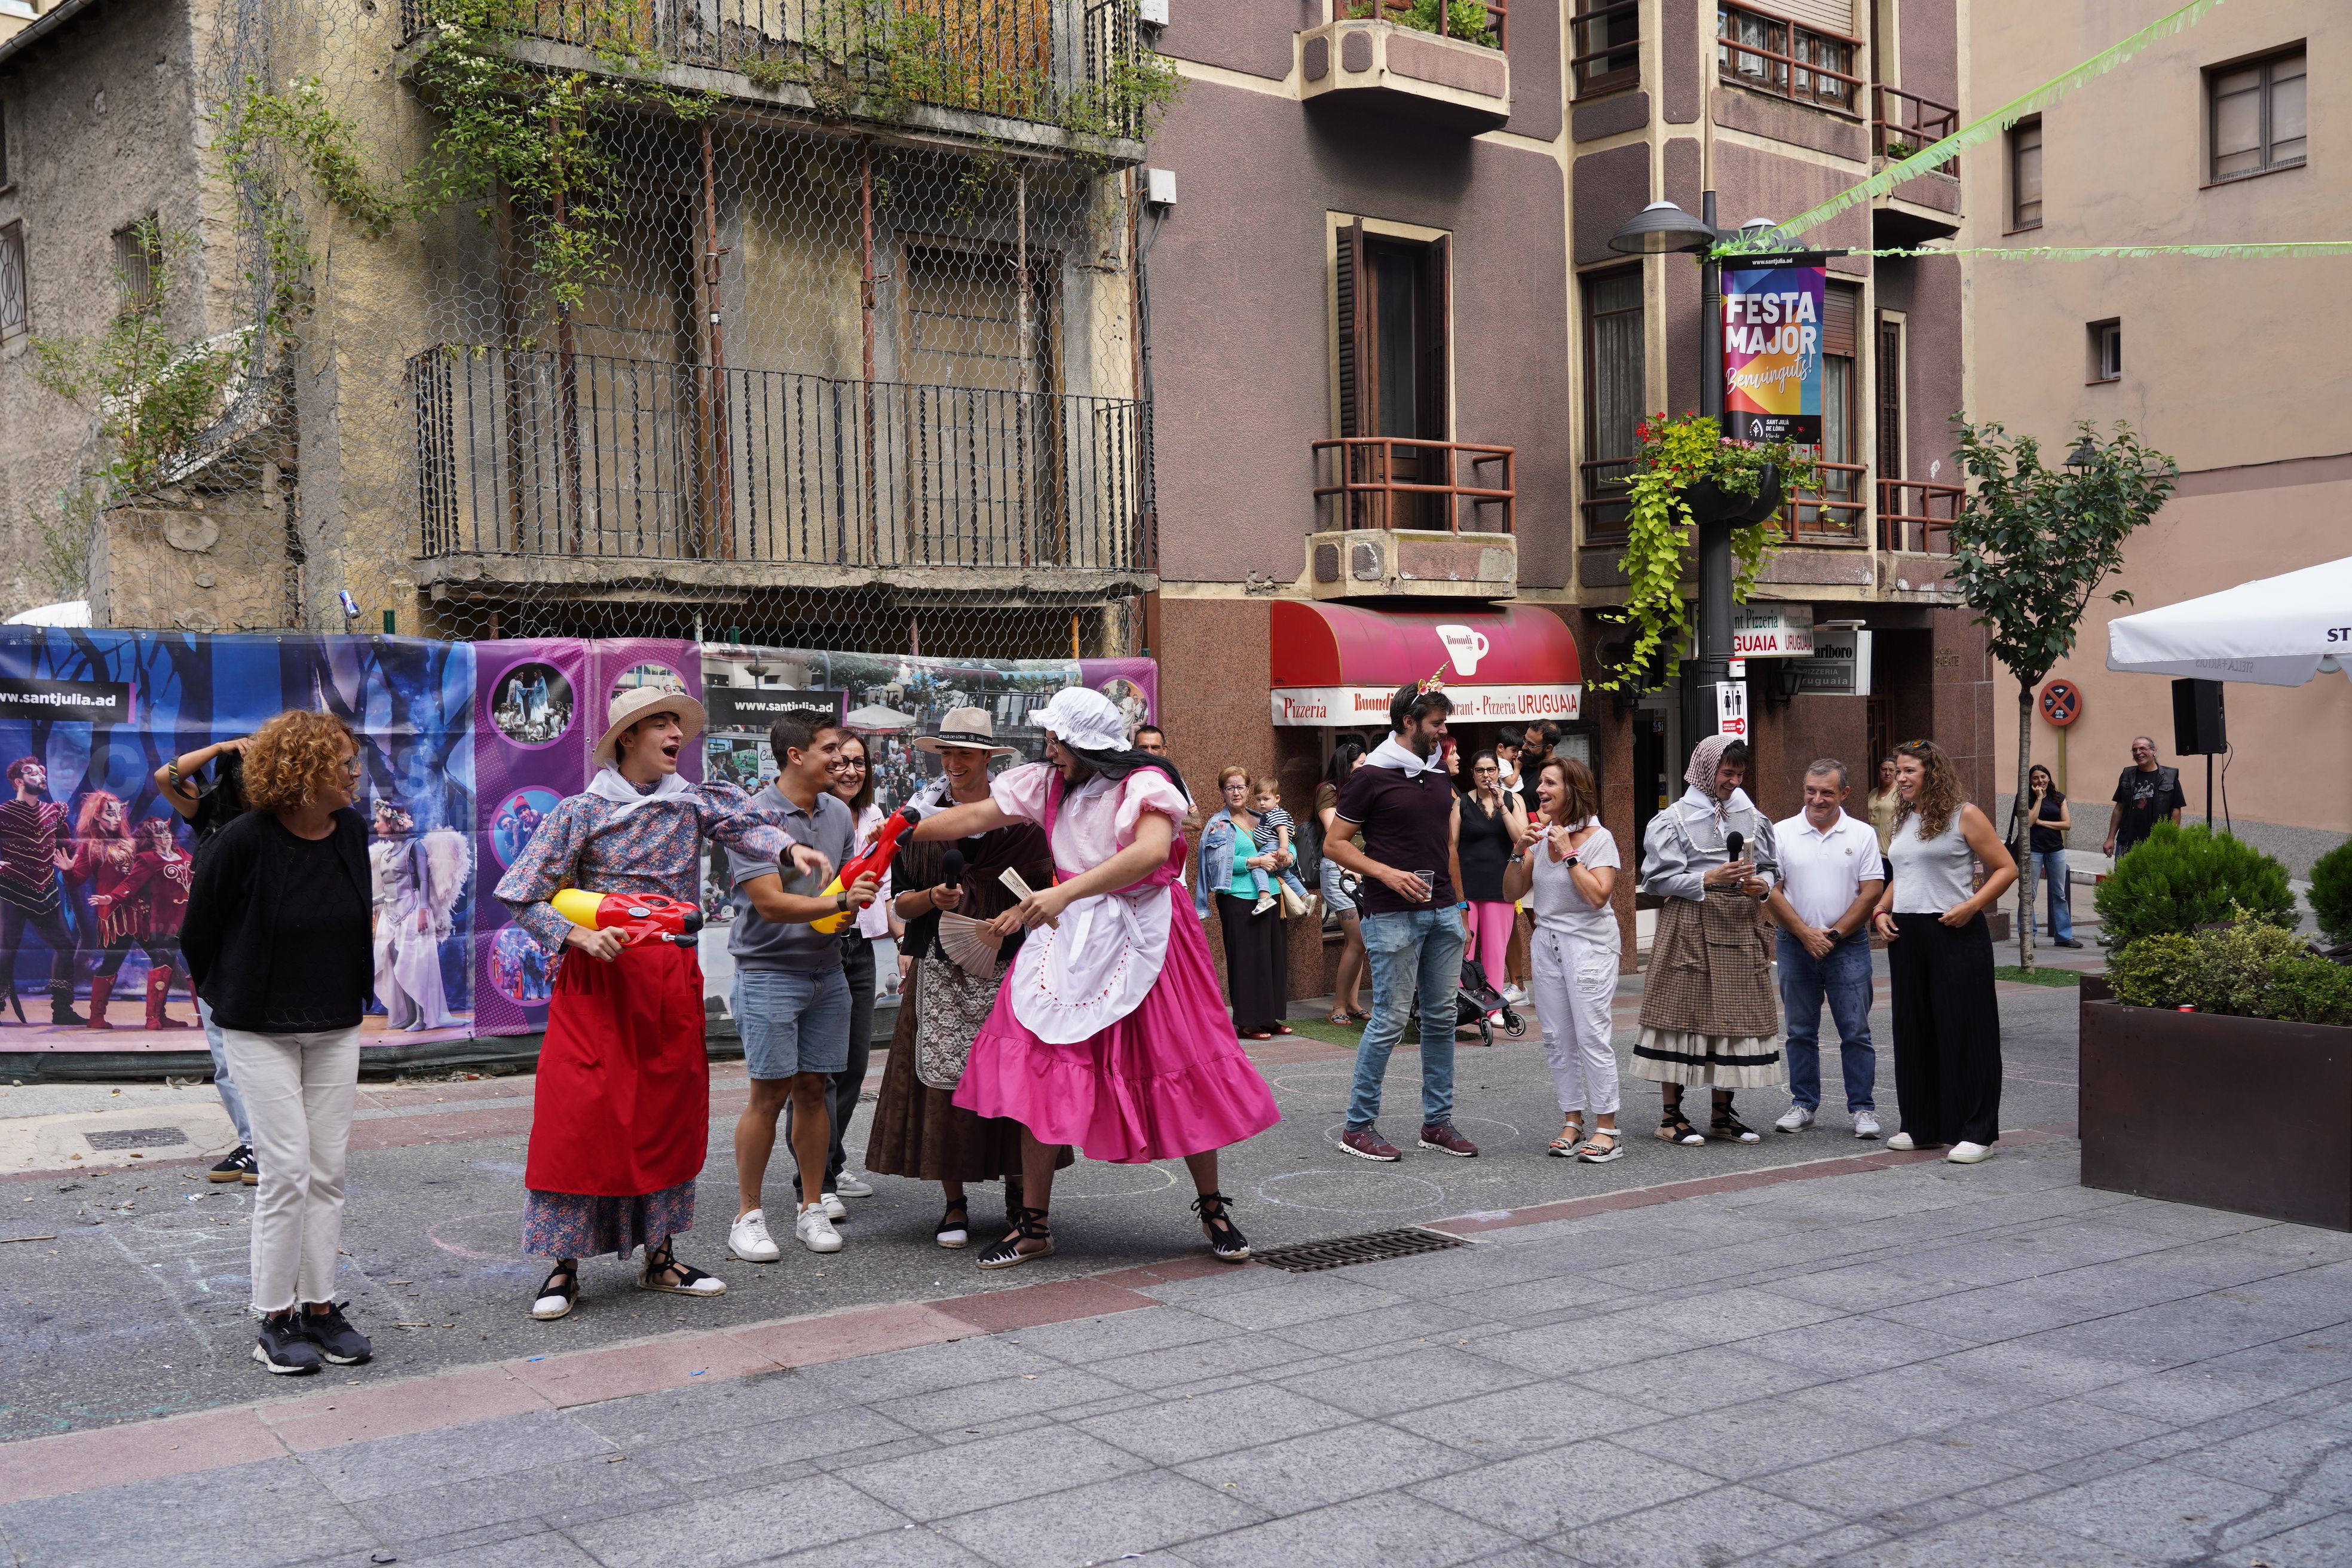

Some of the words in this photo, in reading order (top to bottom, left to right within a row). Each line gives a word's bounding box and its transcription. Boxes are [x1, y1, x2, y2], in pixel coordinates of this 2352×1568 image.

[1726, 292, 1817, 324] FESTA
[1726, 326, 1817, 354] MAJOR
[1726, 353, 1812, 394] Benvinguts!
[1745, 609, 1778, 629] Pizzeria
[1446, 635, 1472, 645] Buondi
[1734, 635, 1777, 651] GUAIA
[1785, 635, 1813, 651] URUGUAIA
[1814, 644, 1852, 658] arlboro
[1802, 677, 1848, 685] ruguaia
[1284, 697, 1327, 718] Pizzeria
[1483, 695, 1516, 715] Pizzeria
[1518, 694, 1578, 714] URUGUAIA
